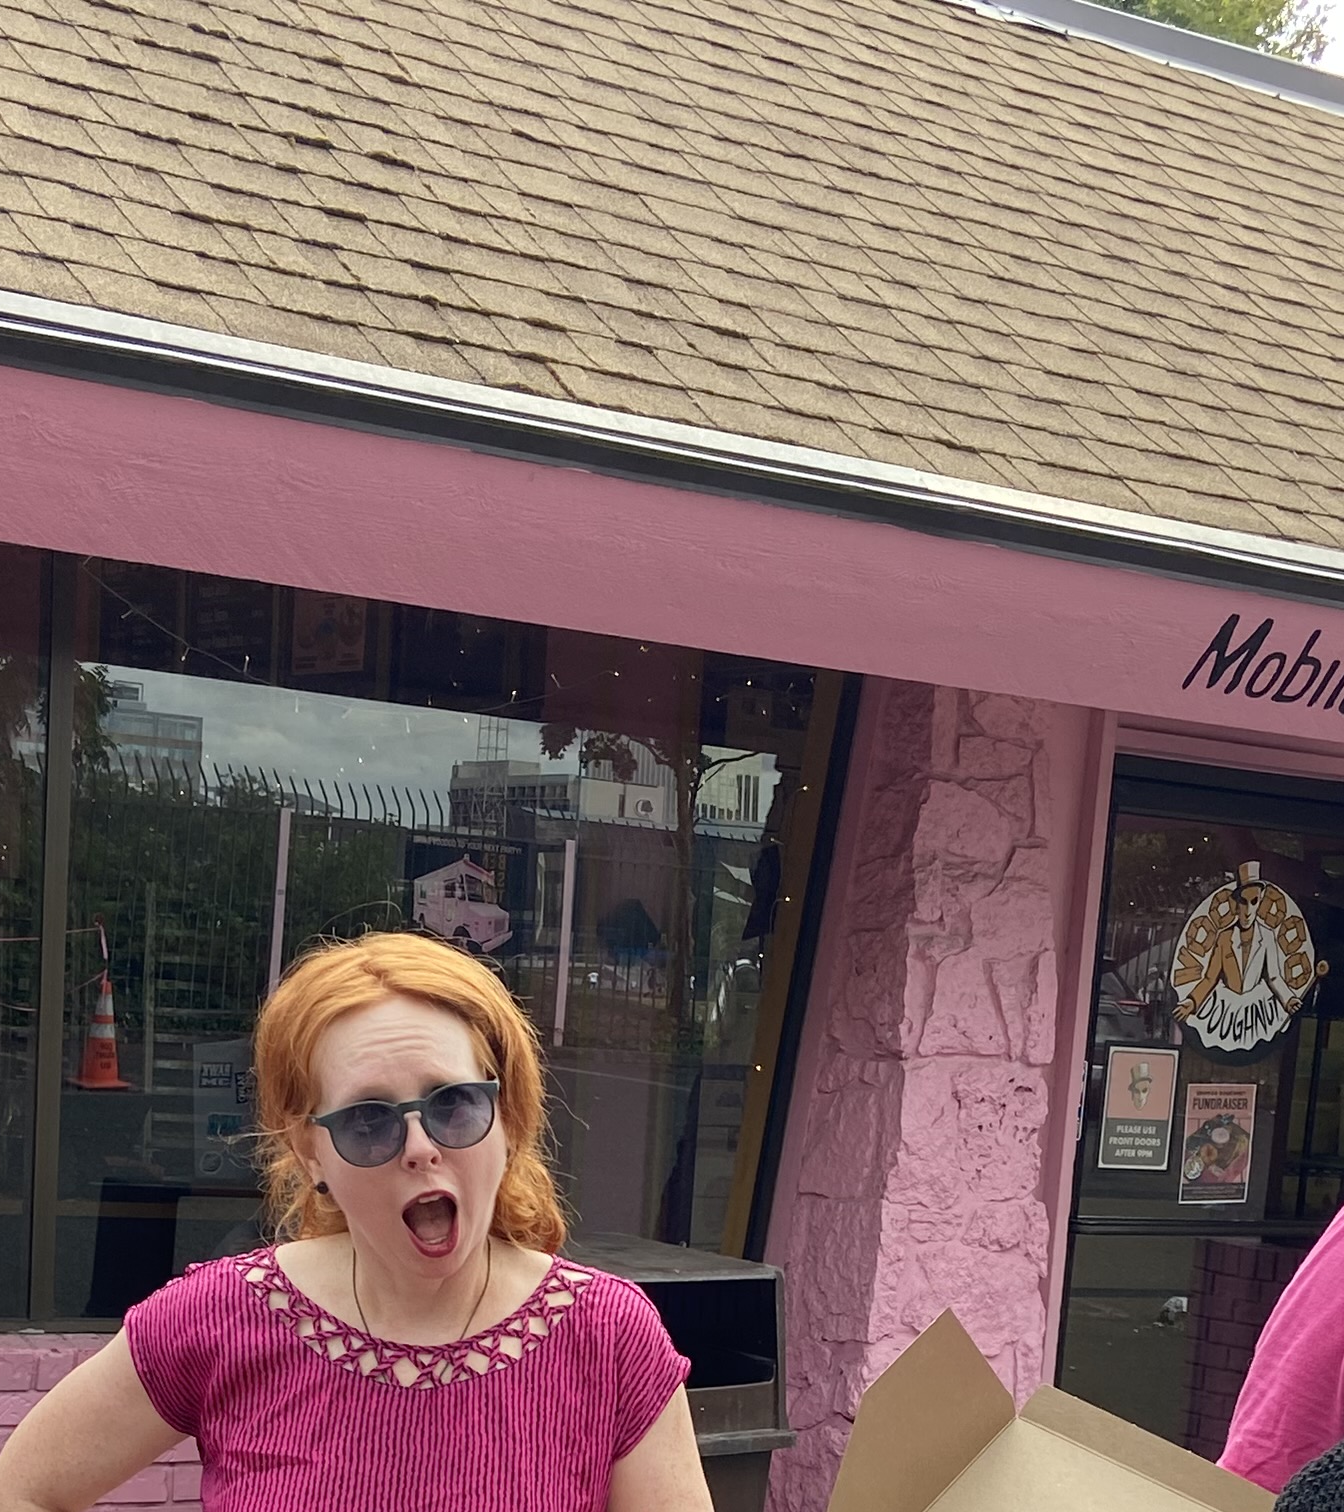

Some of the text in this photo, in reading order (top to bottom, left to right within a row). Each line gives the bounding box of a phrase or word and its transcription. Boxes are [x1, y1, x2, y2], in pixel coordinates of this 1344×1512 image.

[1173, 885, 1312, 990] VOODOO
[1197, 990, 1282, 1043] DOUGHNUT
[1192, 1097, 1249, 1111] FUNDRAISER
[1116, 1125, 1157, 1135] PLEASE USE
[1109, 1136, 1161, 1147] FRONT DOORS
[1114, 1149, 1137, 1158] AFTER
